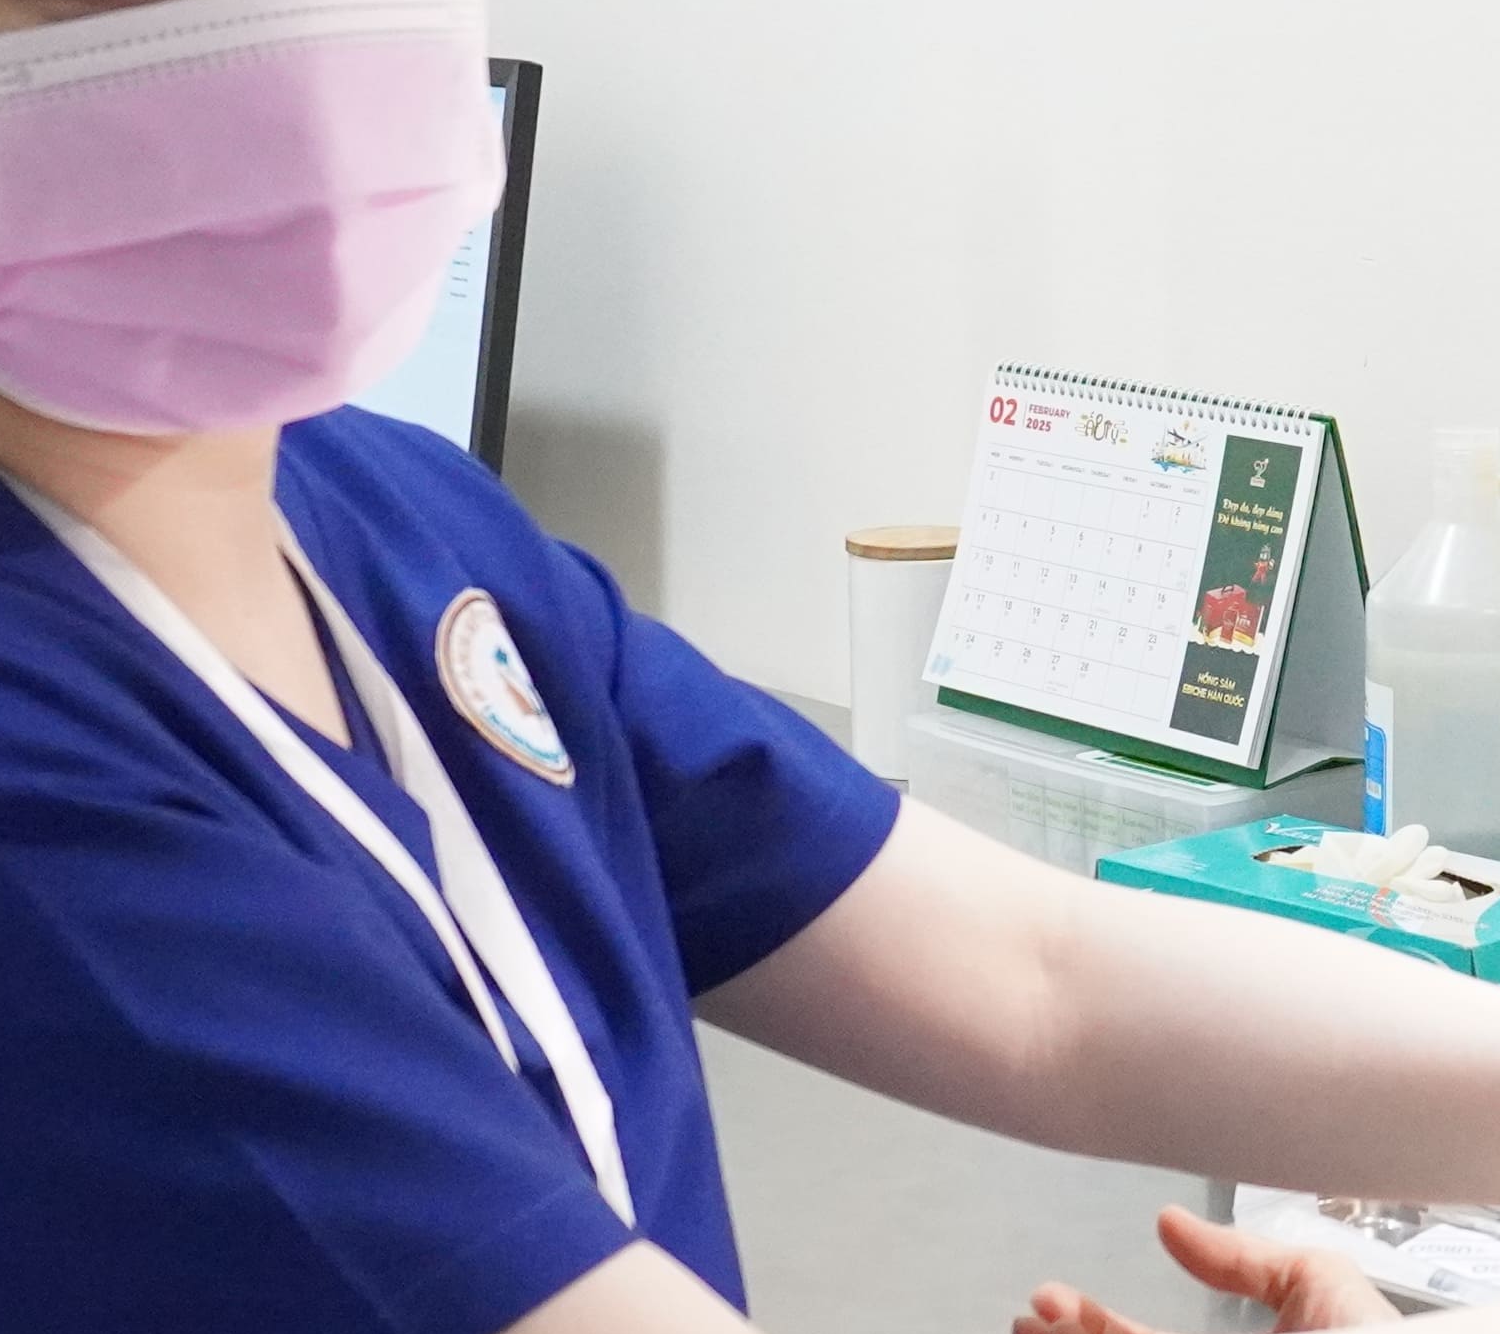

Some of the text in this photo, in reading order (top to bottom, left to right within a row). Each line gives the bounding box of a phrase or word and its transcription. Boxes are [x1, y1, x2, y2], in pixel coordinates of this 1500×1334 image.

[989, 396, 1018, 426] 02
[1029, 403, 1071, 420] FEBRUARY
[1025, 417, 1052, 432] 2025
[1148, 634, 1157, 644] 23
